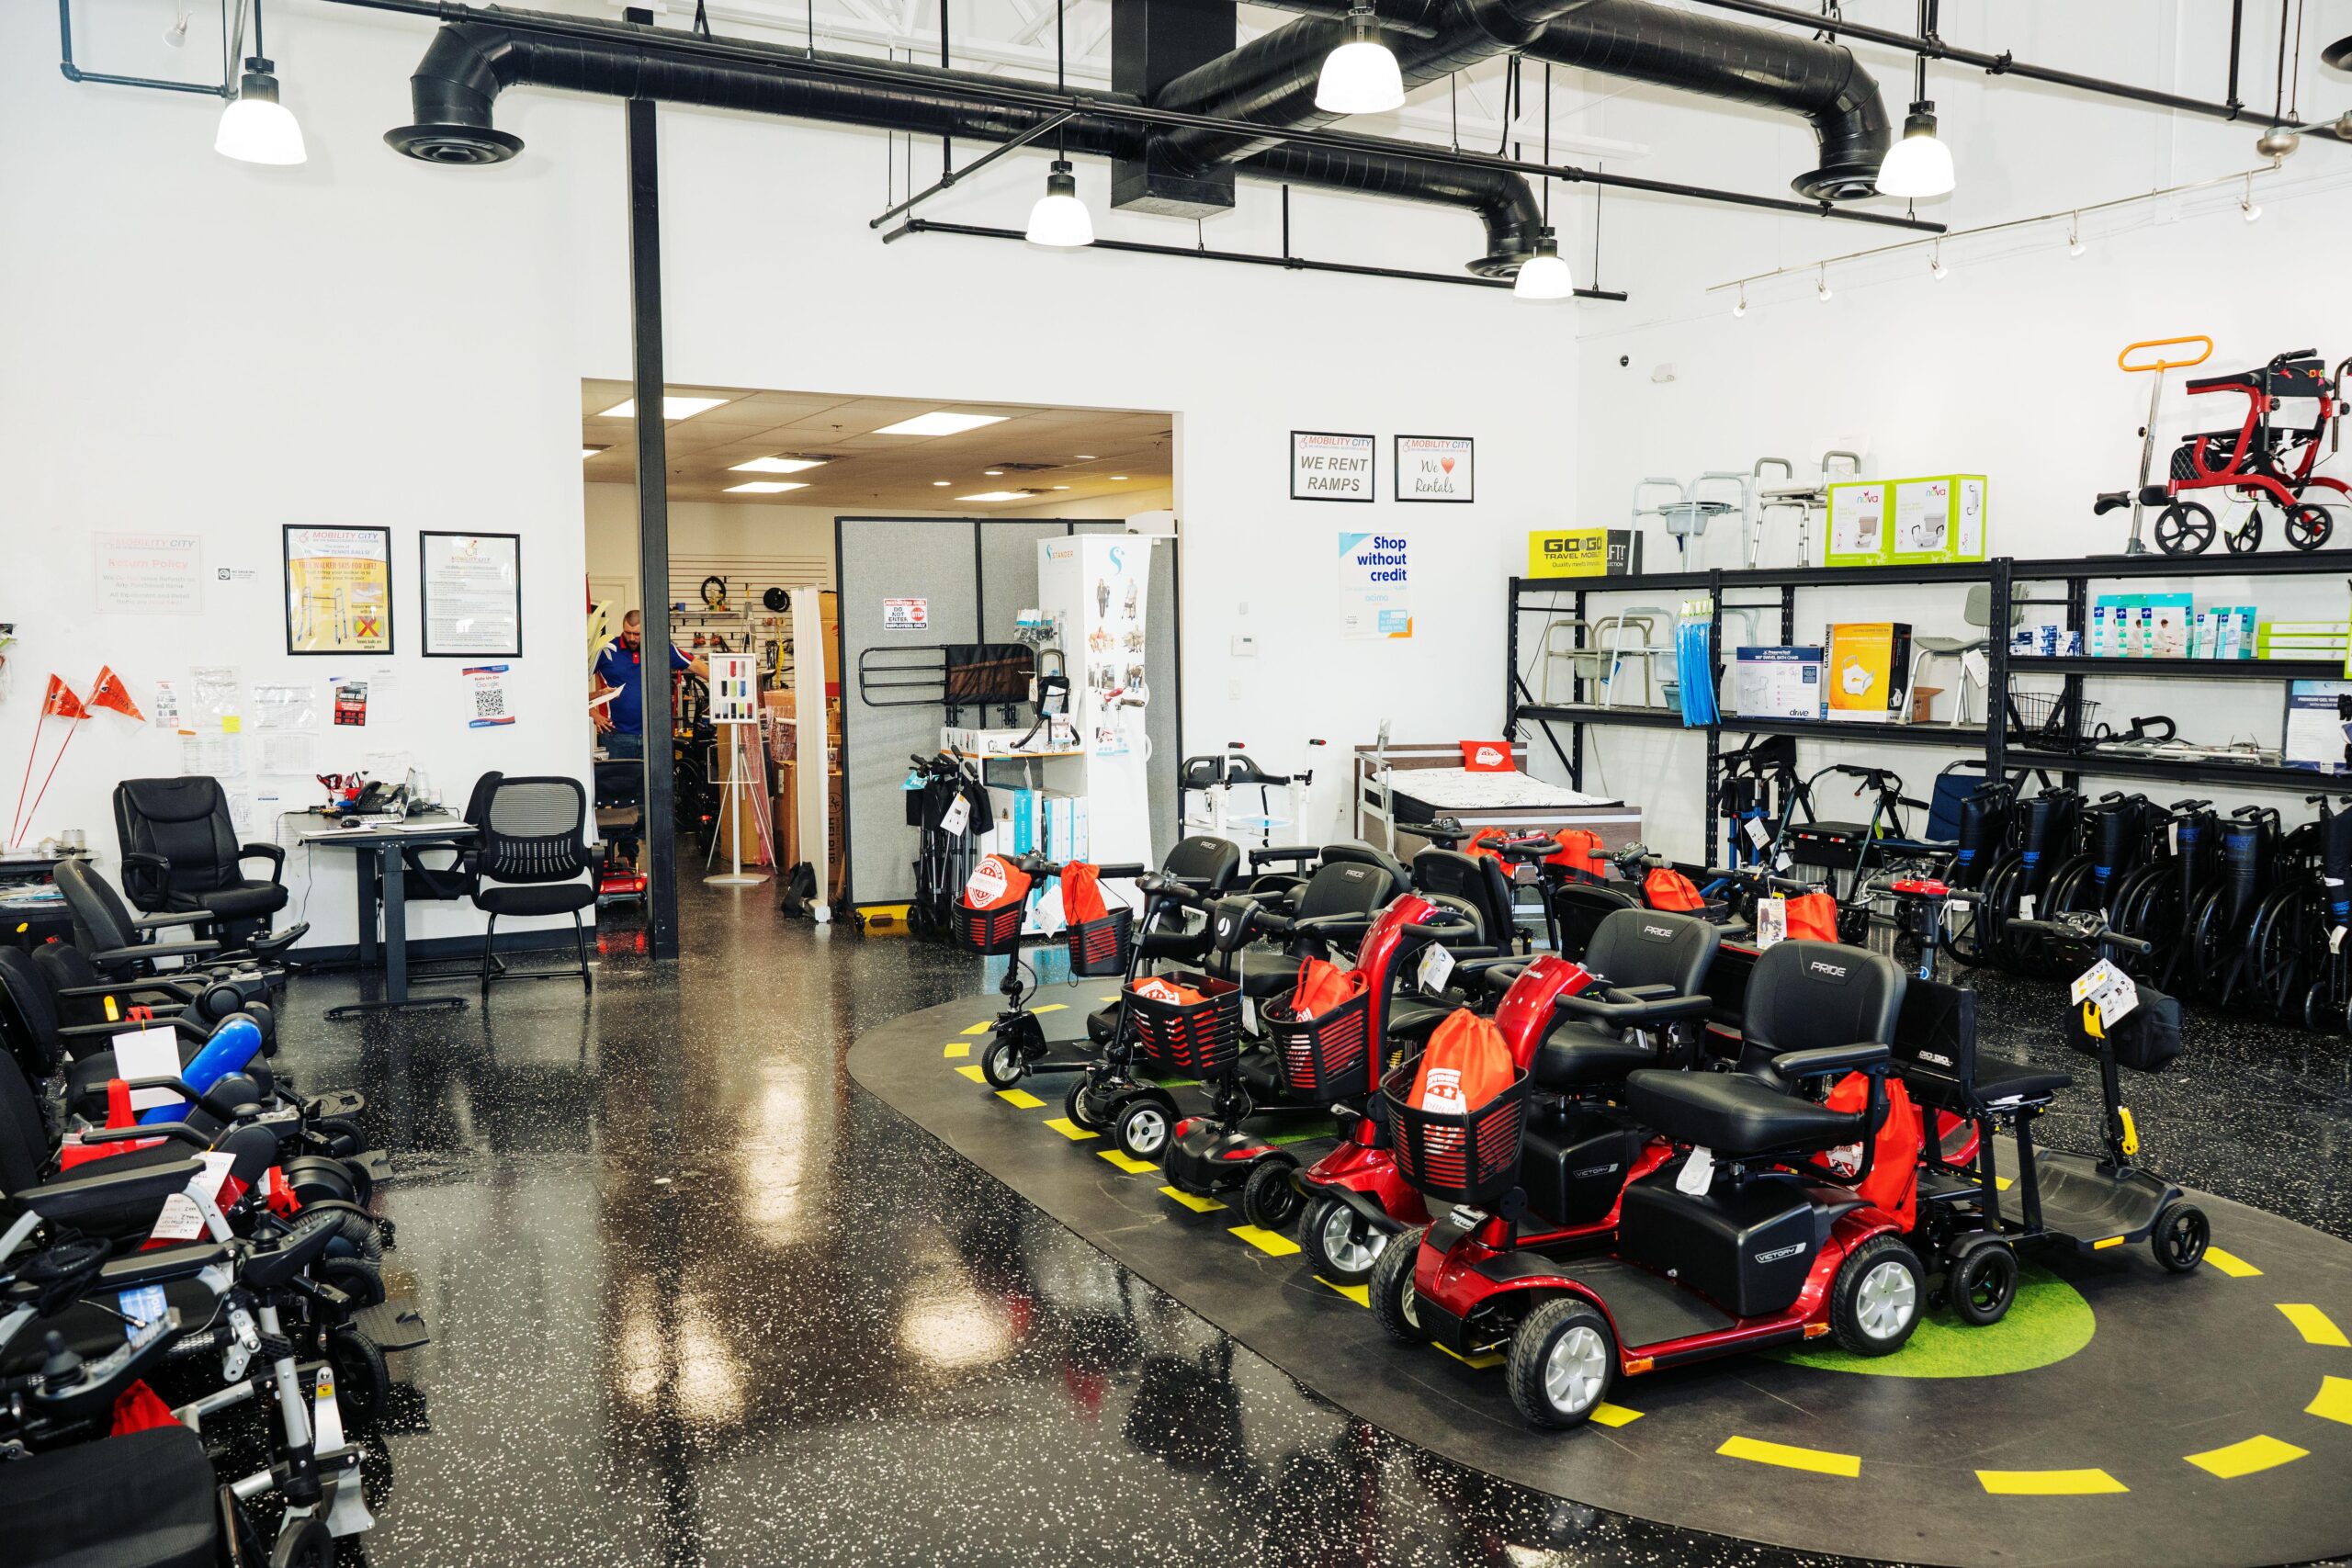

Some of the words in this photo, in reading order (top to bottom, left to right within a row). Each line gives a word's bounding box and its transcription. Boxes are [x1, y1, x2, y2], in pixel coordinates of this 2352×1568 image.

[1308, 436, 1351, 446] MOBILITY
[1351, 438, 1372, 447] CITY
[1411, 440, 1451, 448] MOBILITY
[1452, 441, 1470, 449] CITY
[1301, 456, 1325, 469] WE
[1328, 457, 1369, 471] RENT
[1421, 459, 1440, 473] We
[1307, 477, 1361, 491] RAMPS
[1415, 477, 1455, 493] Rentals
[1926, 487, 1946, 496] nova
[1857, 493, 1879, 503] nova
[312, 531, 356, 539] MOBILITY
[170, 539, 196, 547] CITY
[1374, 536, 1407, 552] Shop
[1052, 550, 1074, 559] STANDER
[1357, 552, 1407, 565] without
[108, 558, 148, 567] Return
[152, 558, 189, 570] Policy
[1370, 569, 1408, 581] credit
[1789, 708, 1809, 716] drive
[1200, 840, 1217, 850] PRIDE
[1345, 869, 1365, 878] PRIDE
[1644, 925, 1673, 938] PRIDE
[1810, 961, 1847, 977] PRIDE
[1576, 1167, 1609, 1177] VICTORY
[1758, 1247, 1795, 1261] VICTORY
